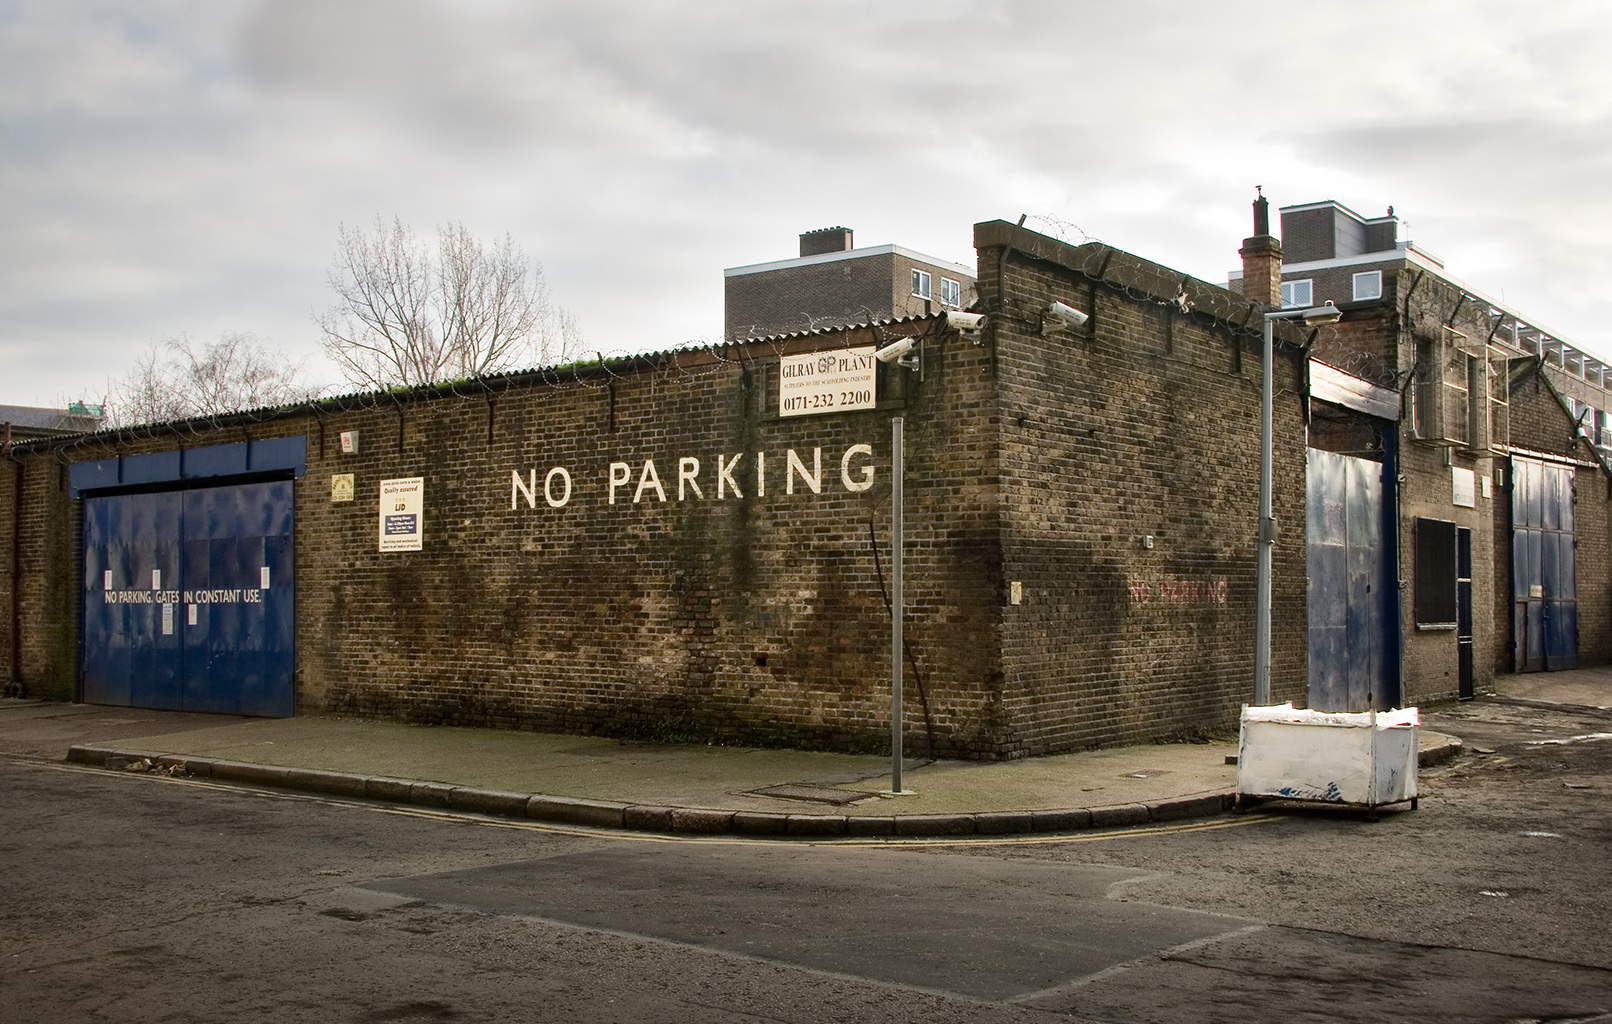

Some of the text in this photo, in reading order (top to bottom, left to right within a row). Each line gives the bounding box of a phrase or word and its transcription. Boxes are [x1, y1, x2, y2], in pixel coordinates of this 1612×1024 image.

[782, 362, 815, 378] GILRAY
[838, 355, 874, 372] PLANT
[784, 389, 871, 411] 0171-232 2200
[511, 443, 875, 510] NO PARKING
[384, 485, 418, 494] Quality assured
[105, 589, 262, 603] NO PARKING. GATES IN CONSTANT USE.
